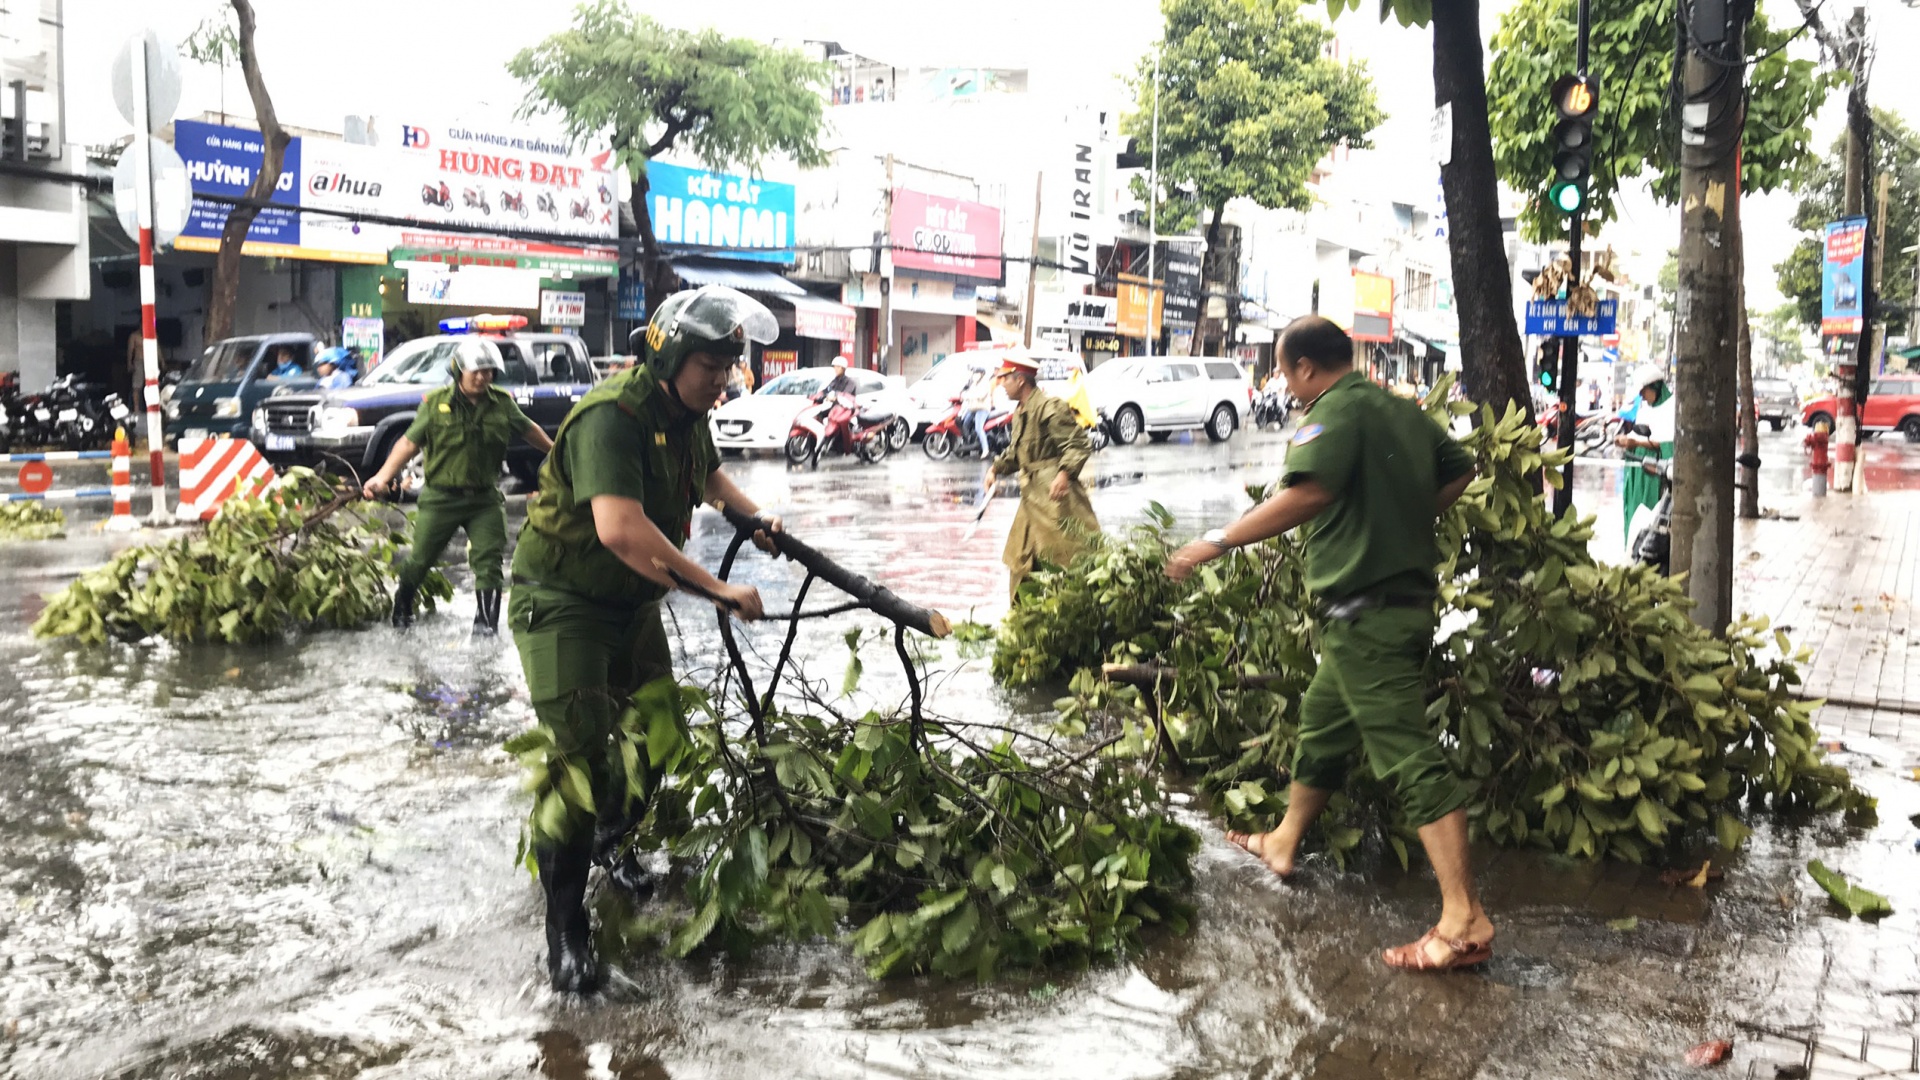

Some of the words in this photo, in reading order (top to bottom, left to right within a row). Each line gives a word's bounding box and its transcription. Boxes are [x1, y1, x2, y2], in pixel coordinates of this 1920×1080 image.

[1570, 83, 1590, 110] 16
[402, 125, 430, 150] HD
[510, 138, 525, 149] XE
[438, 147, 523, 181] HÙNG
[530, 161, 583, 191] ĐẠT
[655, 194, 787, 248] HANMI
[646, 322, 666, 352] 113
[1543, 319, 1556, 331] KHI
